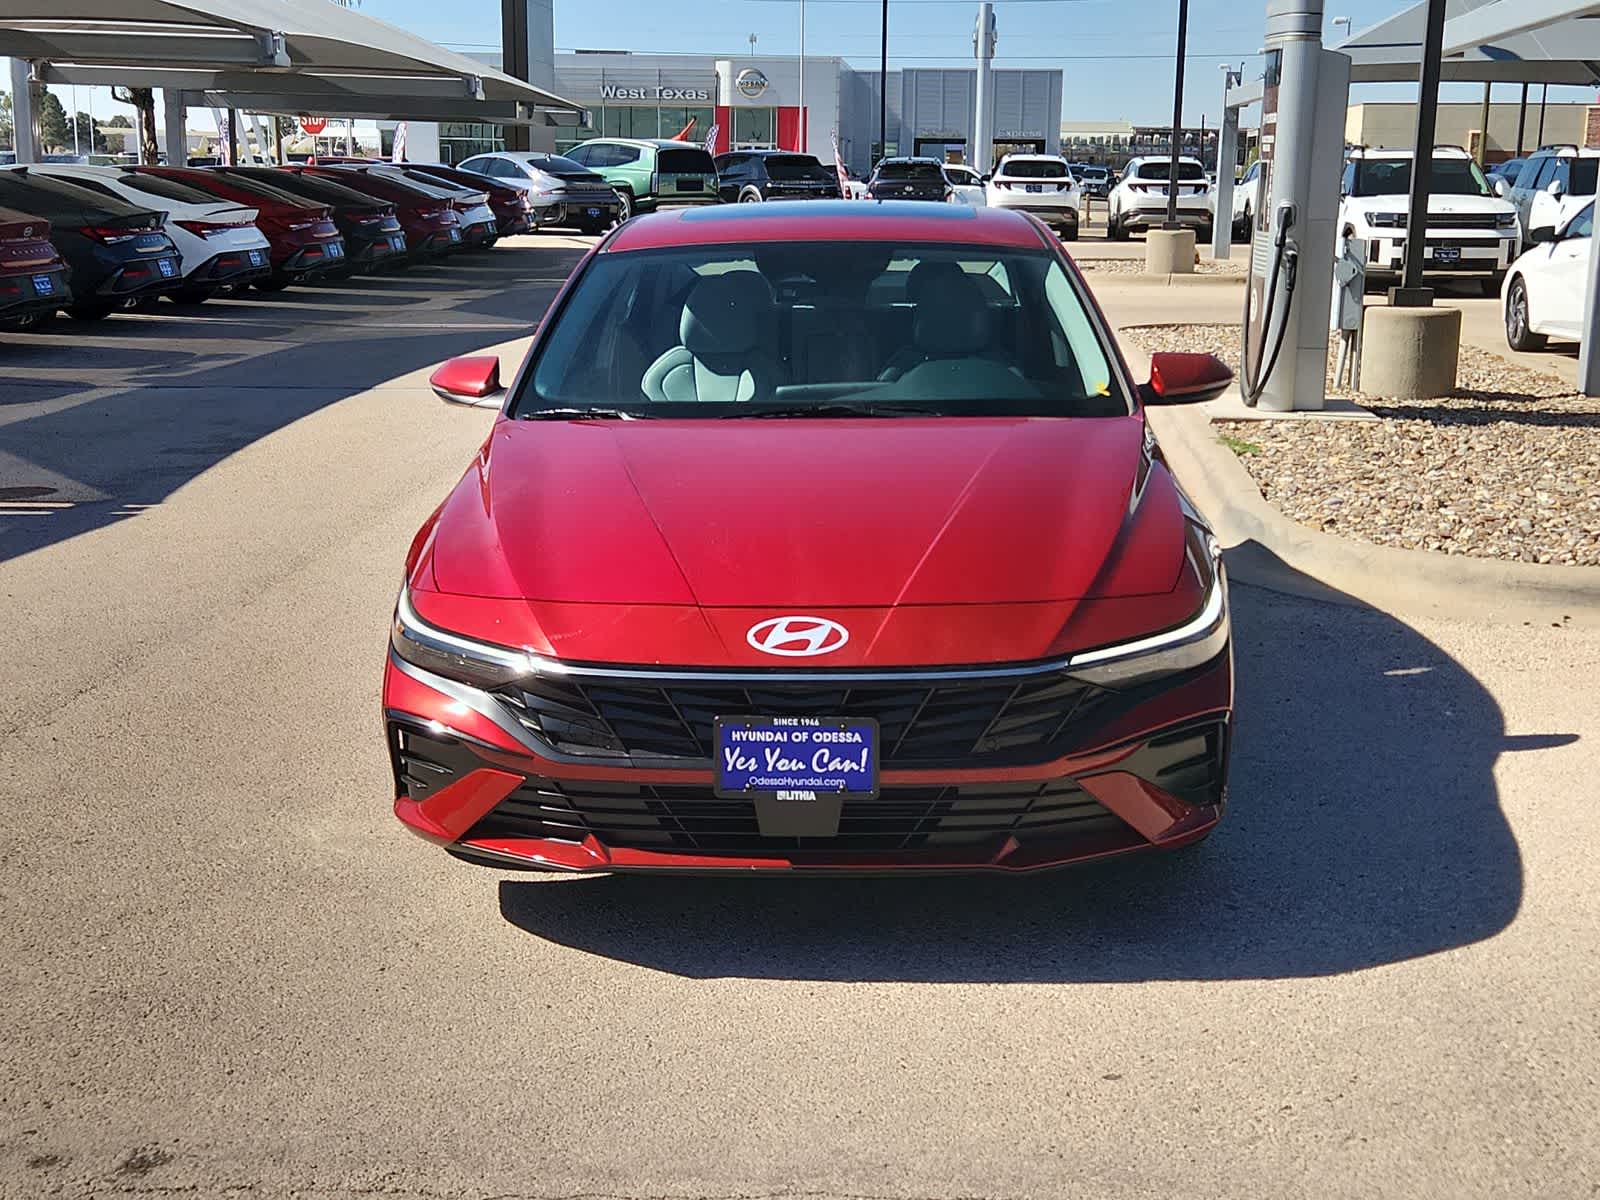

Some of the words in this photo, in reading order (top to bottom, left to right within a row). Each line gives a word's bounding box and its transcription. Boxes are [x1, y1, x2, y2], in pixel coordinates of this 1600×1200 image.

[599, 85, 645, 99] West
[653, 86, 708, 100] Texas
[773, 718, 798, 726] SINCE
[801, 718, 820, 726] 1946
[732, 731, 788, 742] HYUNDAI
[791, 732, 808, 743] OF
[812, 732, 862, 743] ODESSA
[724, 747, 758, 772] Yes
[764, 747, 806, 772] You
[812, 747, 869, 773] Can!
[749, 776, 846, 788] OdessaHyundai.com
[787, 791, 816, 801] LITHIA
